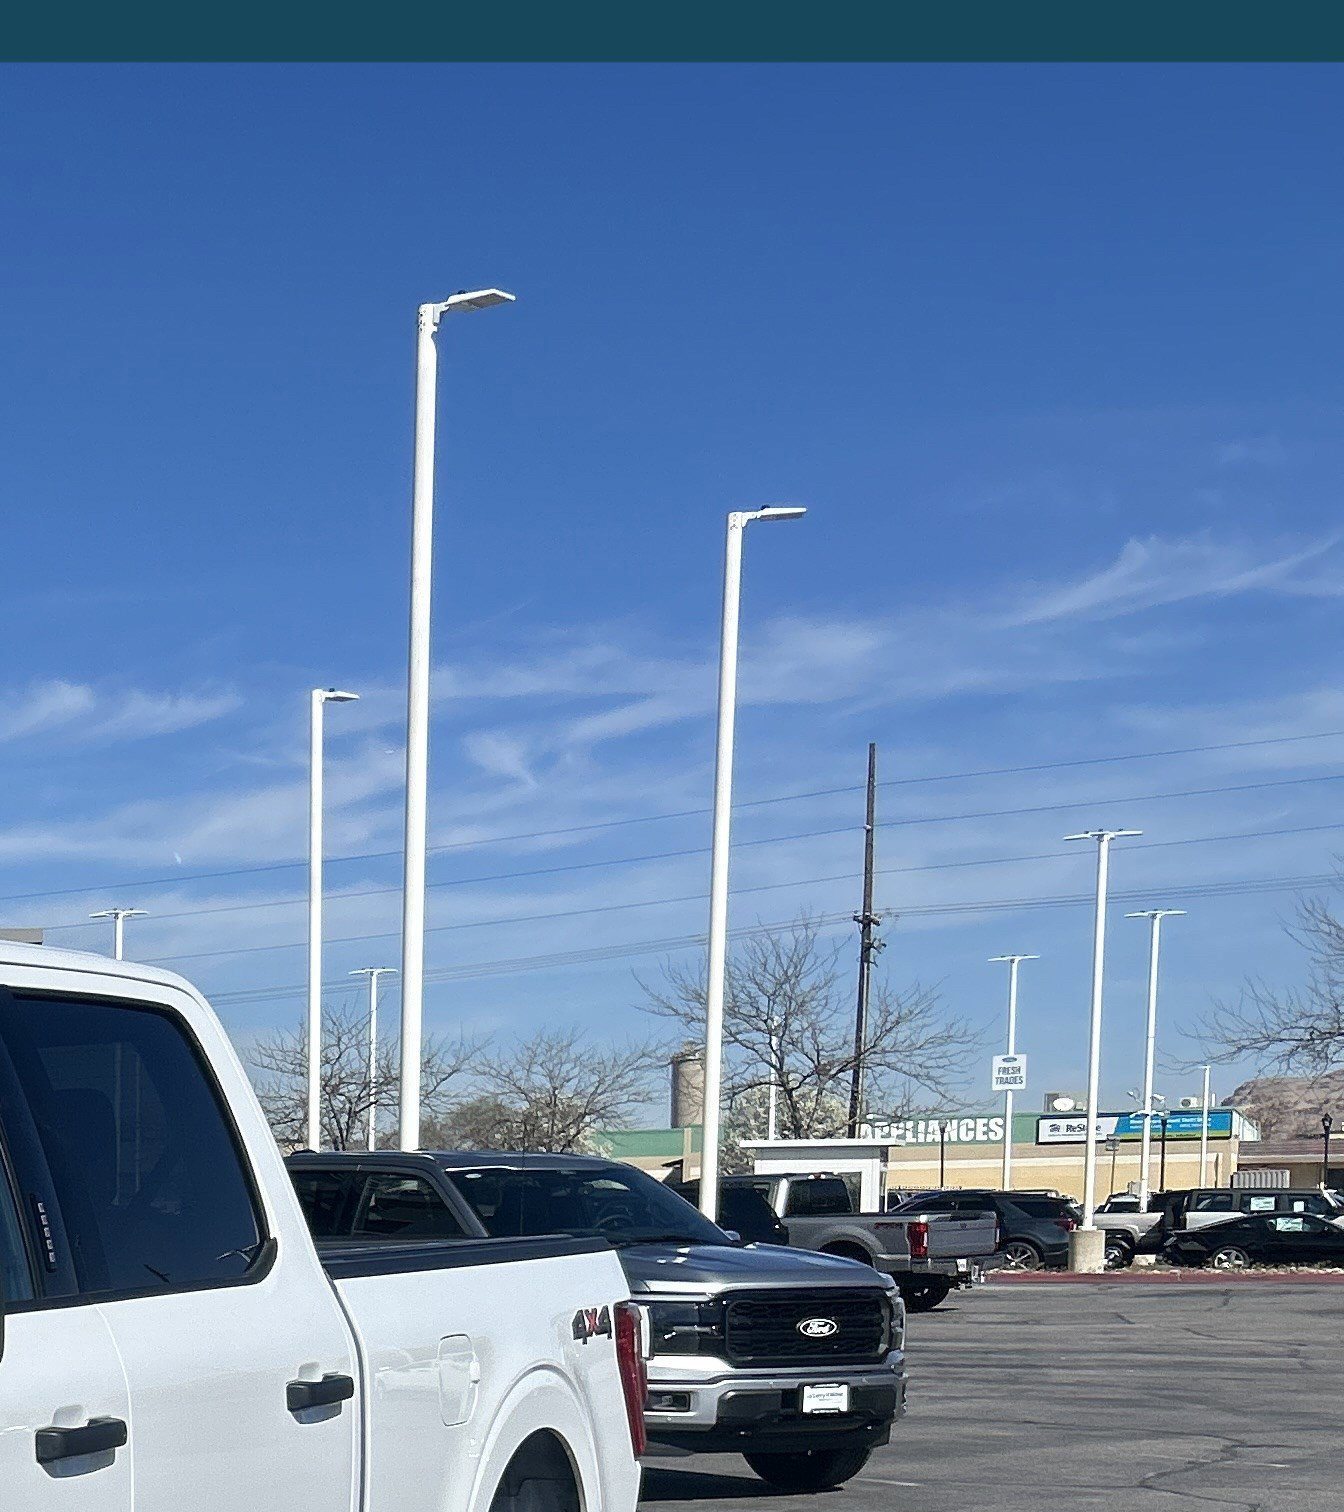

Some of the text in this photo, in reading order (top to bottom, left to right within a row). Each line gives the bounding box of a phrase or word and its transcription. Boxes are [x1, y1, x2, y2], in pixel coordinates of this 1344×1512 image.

[998, 1066, 1021, 1075] FRESH
[995, 1076, 1023, 1085] TRADES
[1066, 1124, 1101, 1133] ReSte
